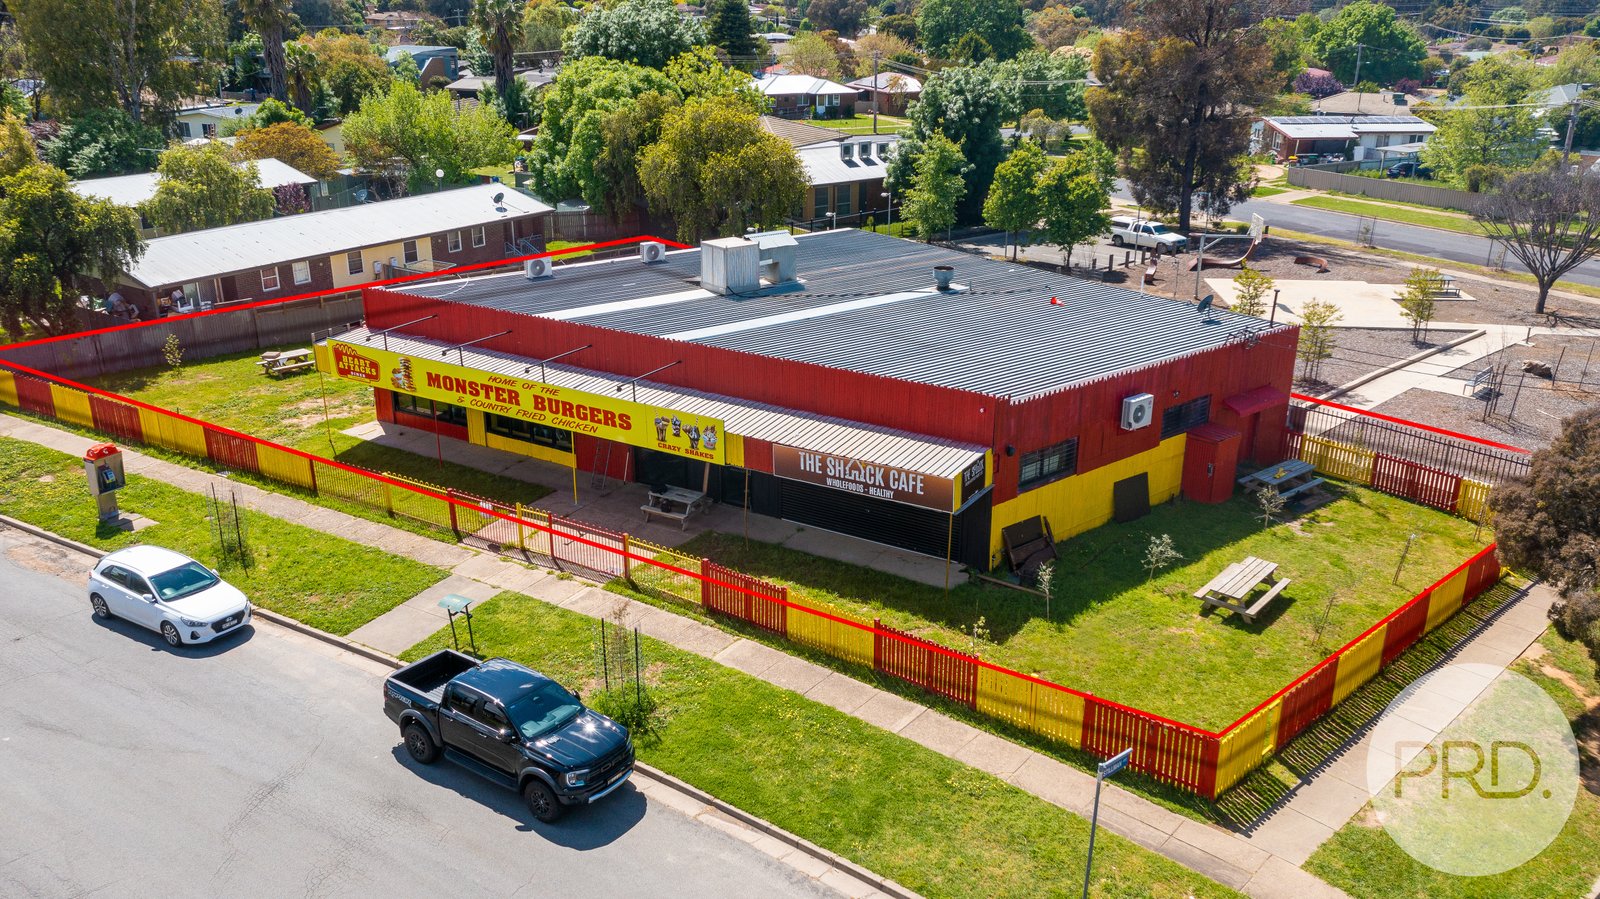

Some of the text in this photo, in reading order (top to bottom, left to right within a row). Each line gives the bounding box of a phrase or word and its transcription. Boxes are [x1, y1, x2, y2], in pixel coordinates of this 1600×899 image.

[338, 361, 377, 376] ATTACKS
[342, 355, 371, 368] HEART
[487, 375, 560, 397] HOME OF THE
[426, 371, 632, 431] MONSTER BURGERS
[469, 398, 512, 414] COUNTRY
[515, 409, 547, 422] FRIED
[551, 417, 599, 433] CHICKEN
[657, 442, 714, 460] CRAZY SHAKES
[798, 451, 924, 495] THE SHACK CAFE
[826, 477, 864, 493] WHOLEFOODS
[868, 487, 895, 499] HEALTHY
